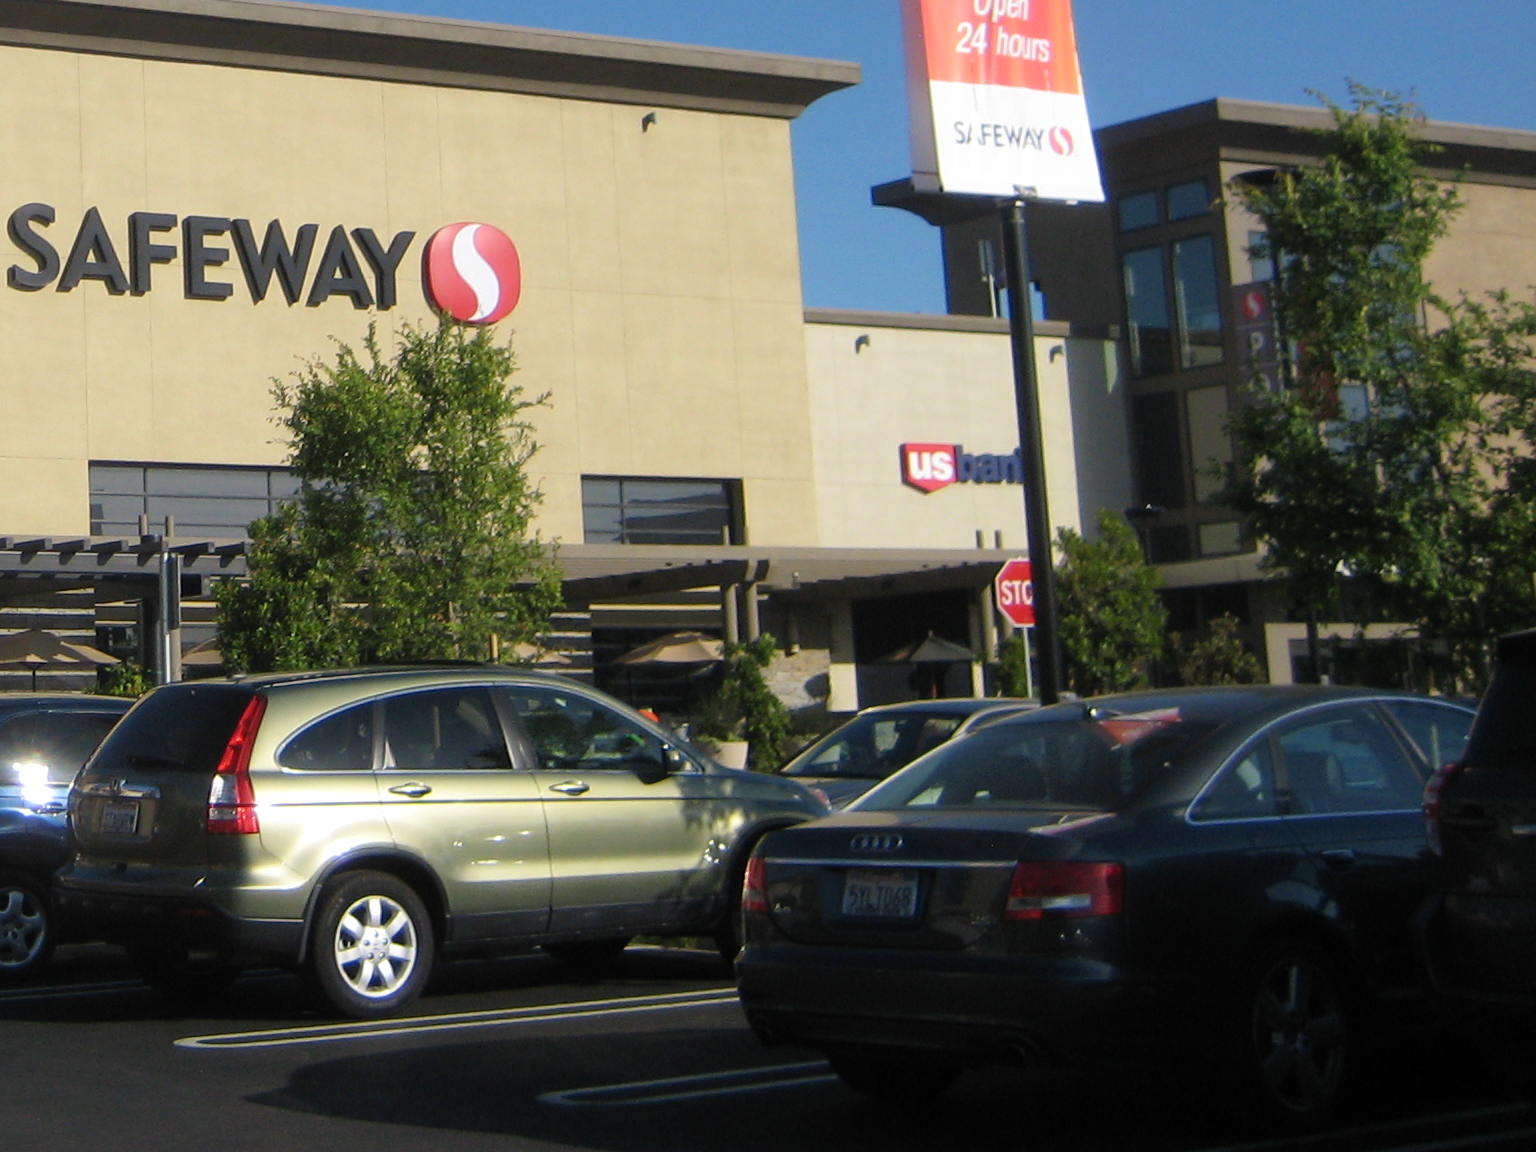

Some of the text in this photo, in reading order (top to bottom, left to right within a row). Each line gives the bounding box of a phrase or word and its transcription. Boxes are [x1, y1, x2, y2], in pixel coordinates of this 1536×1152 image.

[955, 21, 1051, 63] 24 hours
[6, 202, 416, 311] SAFEWAY
[907, 450, 954, 481] us
[1000, 579, 1034, 606] STO
